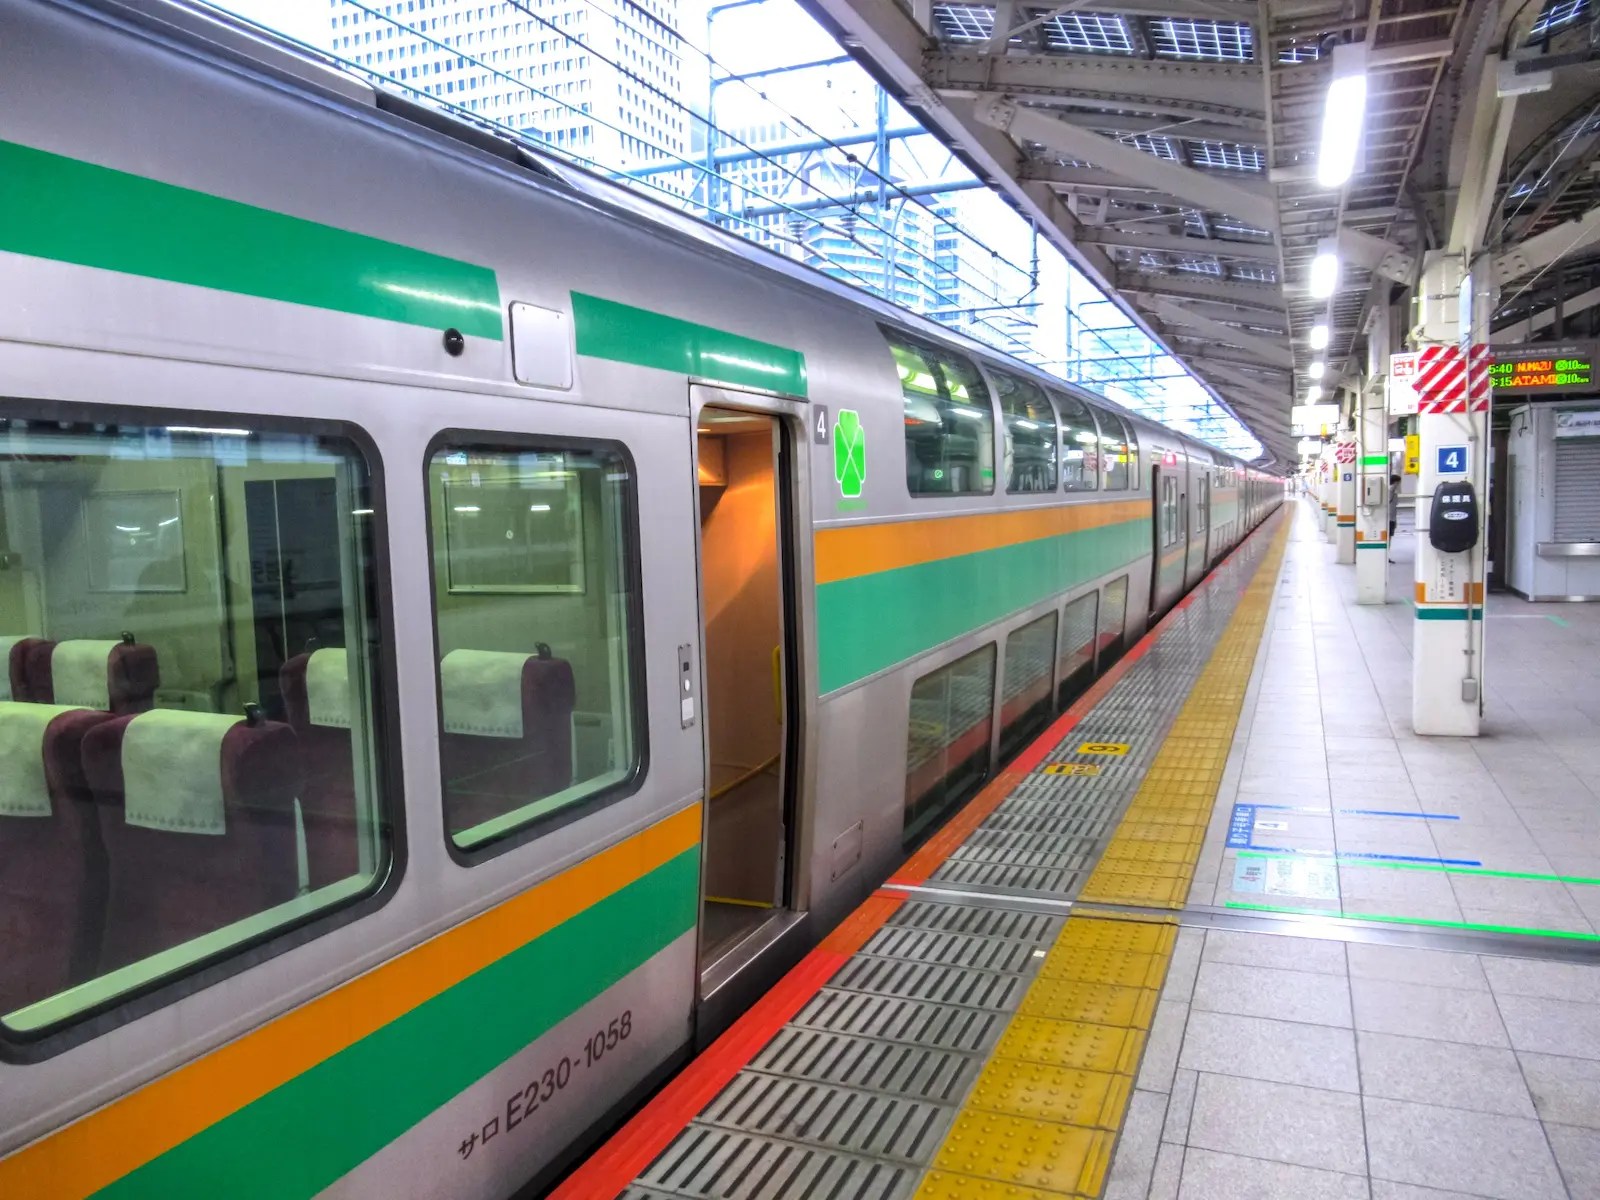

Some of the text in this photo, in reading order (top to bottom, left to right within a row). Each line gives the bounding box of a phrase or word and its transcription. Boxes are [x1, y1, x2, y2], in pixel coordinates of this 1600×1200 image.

[1517, 361, 1552, 372] NUMAZU
[1512, 374, 1557, 386] ATAMI
[817, 411, 826, 439] 4
[1446, 451, 1459, 468] 4
[458, 1009, 632, 1160] サロ E230-1058
